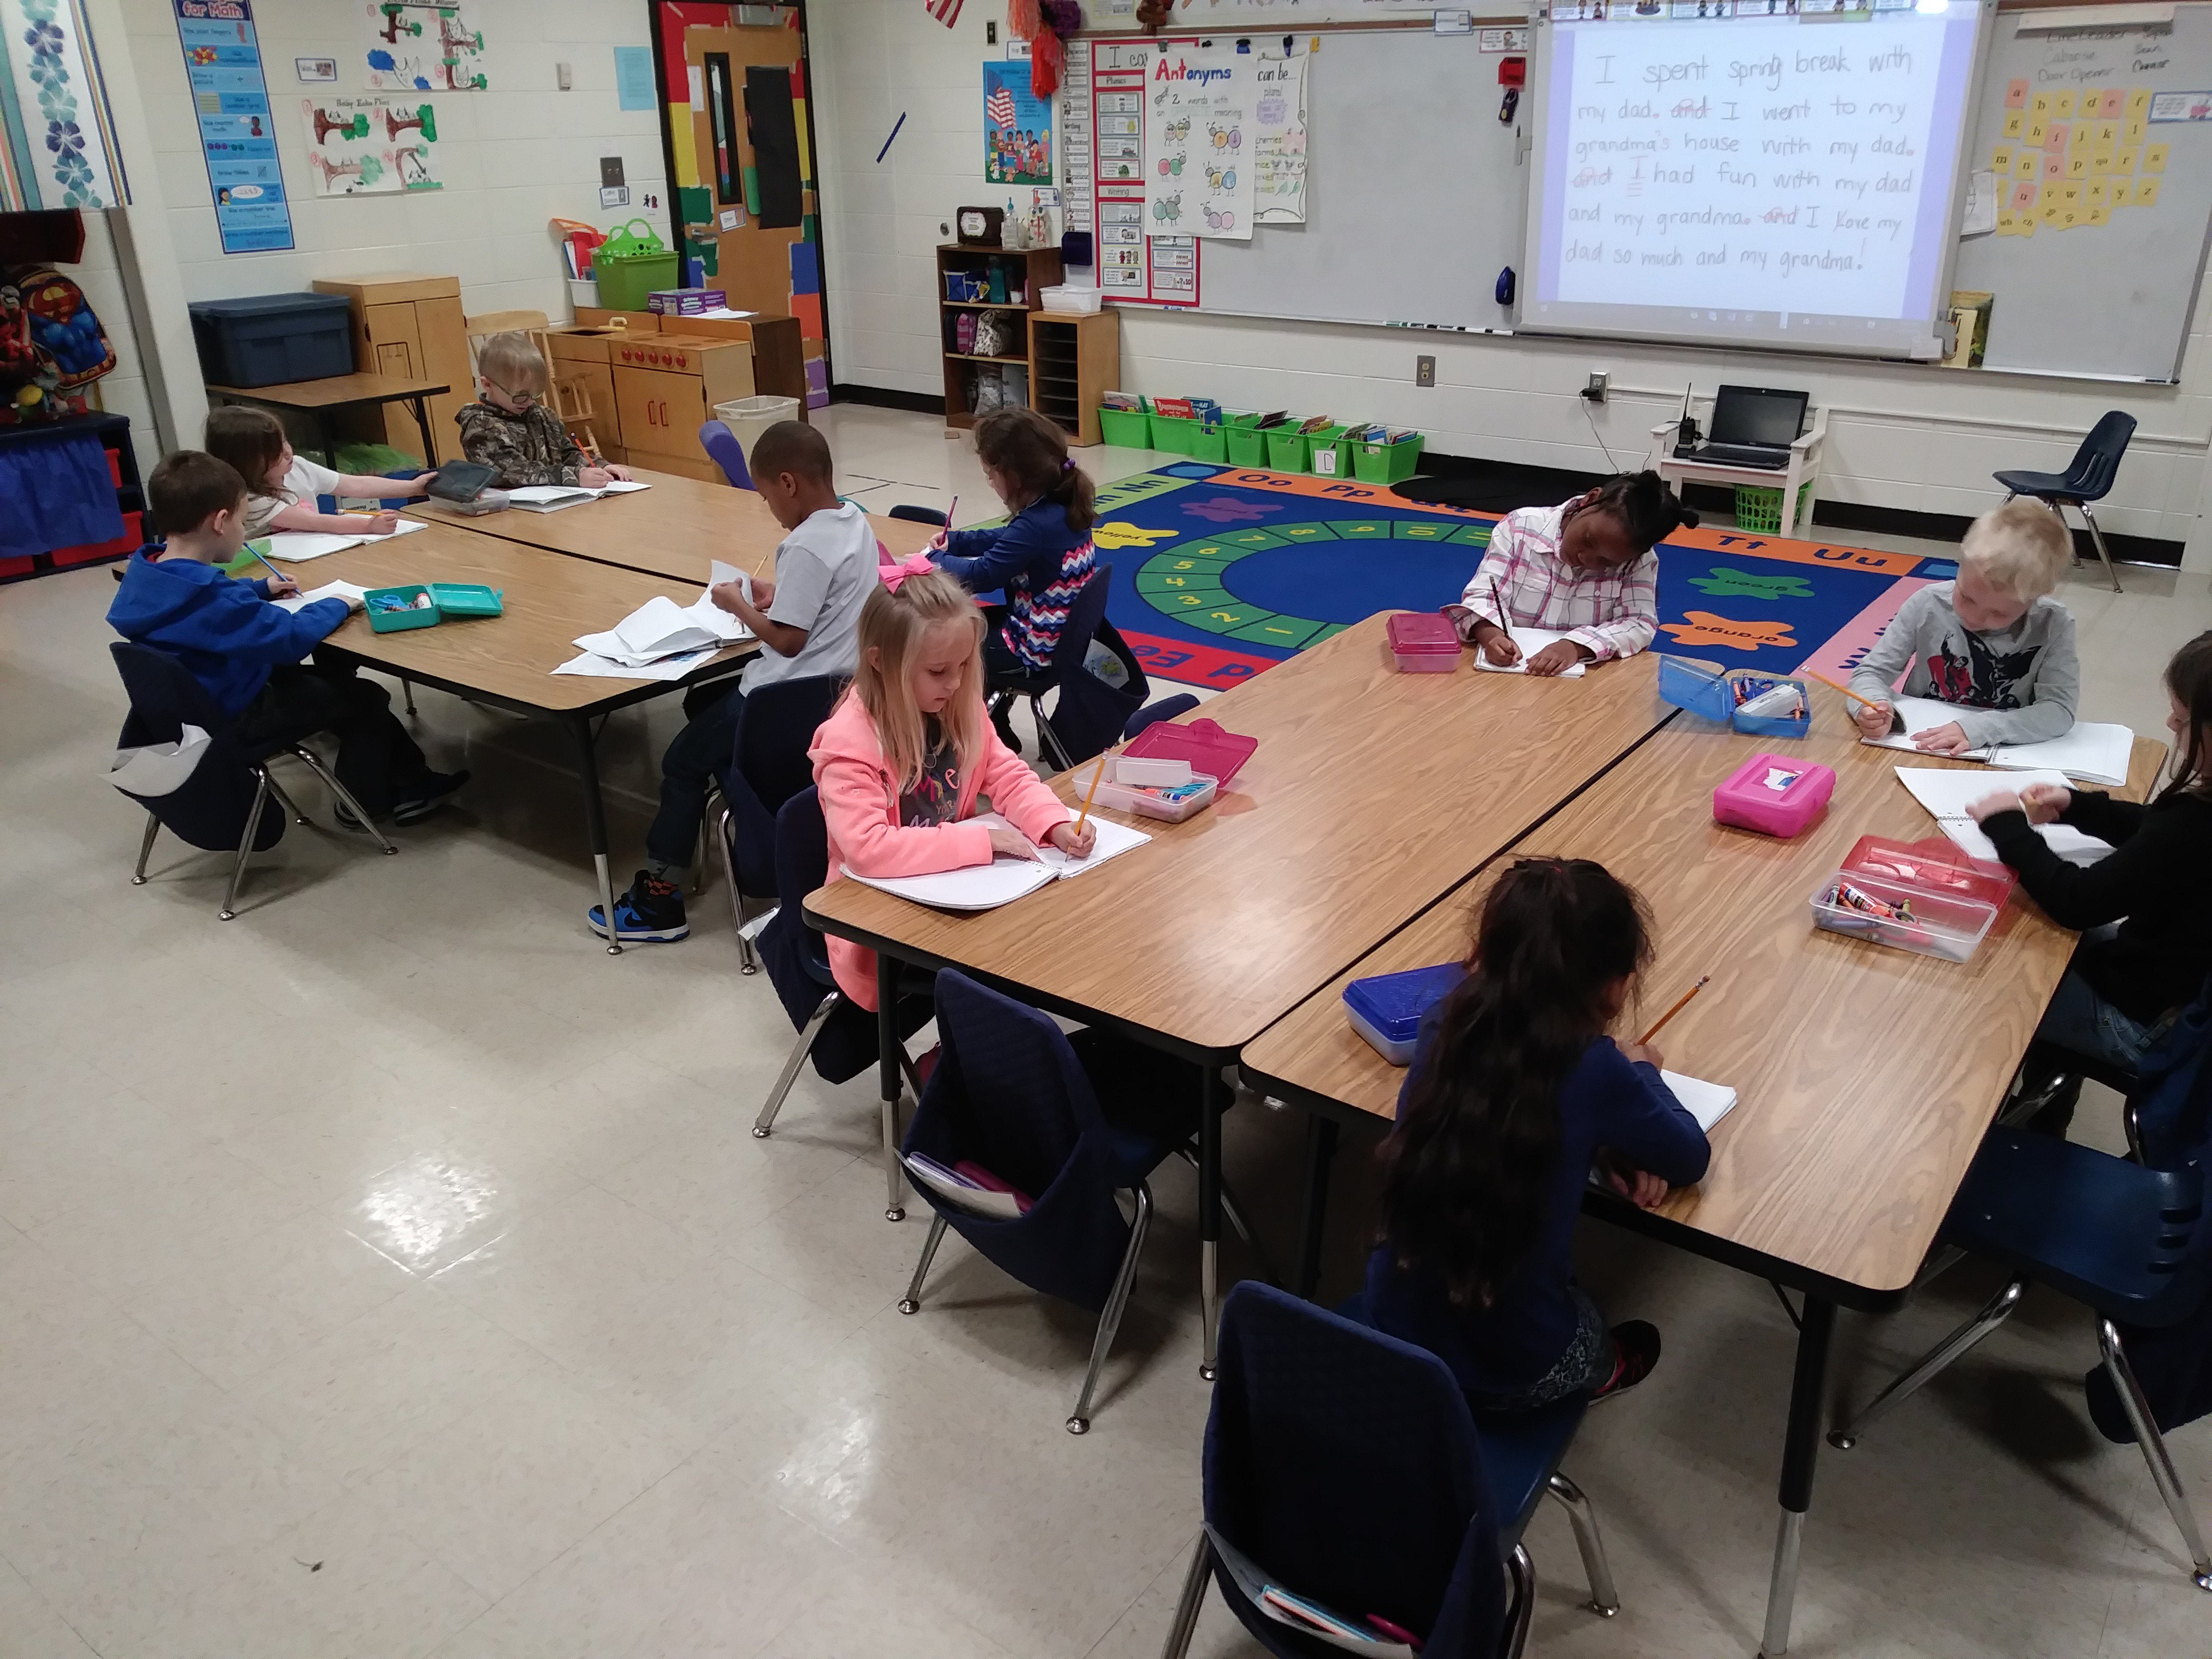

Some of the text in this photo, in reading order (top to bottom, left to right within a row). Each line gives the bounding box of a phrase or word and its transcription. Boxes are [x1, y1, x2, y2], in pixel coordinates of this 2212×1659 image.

[183, 2, 244, 19] for Math
[1109, 46, 1120, 69] I
[1155, 58, 1232, 87] Antonyms
[1257, 69, 1275, 82] can
[1596, 55, 1616, 83] I
[1643, 54, 1708, 93] spent
[1796, 45, 1851, 73] break
[1870, 44, 1911, 74] with
[1172, 94, 1180, 105] 2
[1578, 106, 1605, 123] my
[1618, 99, 1659, 119] dad.
[1721, 102, 1740, 120] I
[1763, 98, 1811, 121] went
[1830, 95, 1856, 115] to
[1869, 103, 1906, 124] my
[1576, 130, 1914, 164] grandma's house with my dad.
[1654, 162, 1694, 183] had
[1717, 161, 1756, 188] fun
[1774, 170, 1819, 189] with
[1835, 178, 1869, 200] my
[1875, 169, 1913, 192] dad
[1108, 188, 1129, 197] Writing
[1569, 203, 1600, 222] and
[1614, 213, 1644, 236] my
[1657, 205, 1750, 235] grandma.
[1805, 206, 1821, 229] I
[1877, 219, 1902, 241] my
[1566, 239, 1602, 263] dad
[1613, 248, 1631, 264] so
[1641, 245, 1683, 266] much
[1696, 243, 1726, 266] and
[1740, 250, 1767, 272] my
[1237, 474, 1375, 498] Oo Pp
[1407, 526, 1438, 536] 10
[1717, 535, 1888, 567] Tt Uu
[1173, 561, 1195, 569] 5
[1166, 578, 1186, 586] 4
[1724, 579, 1789, 592] green
[1178, 596, 1202, 605] 3
[1211, 613, 1241, 623] 2
[1694, 625, 1779, 642] orange
